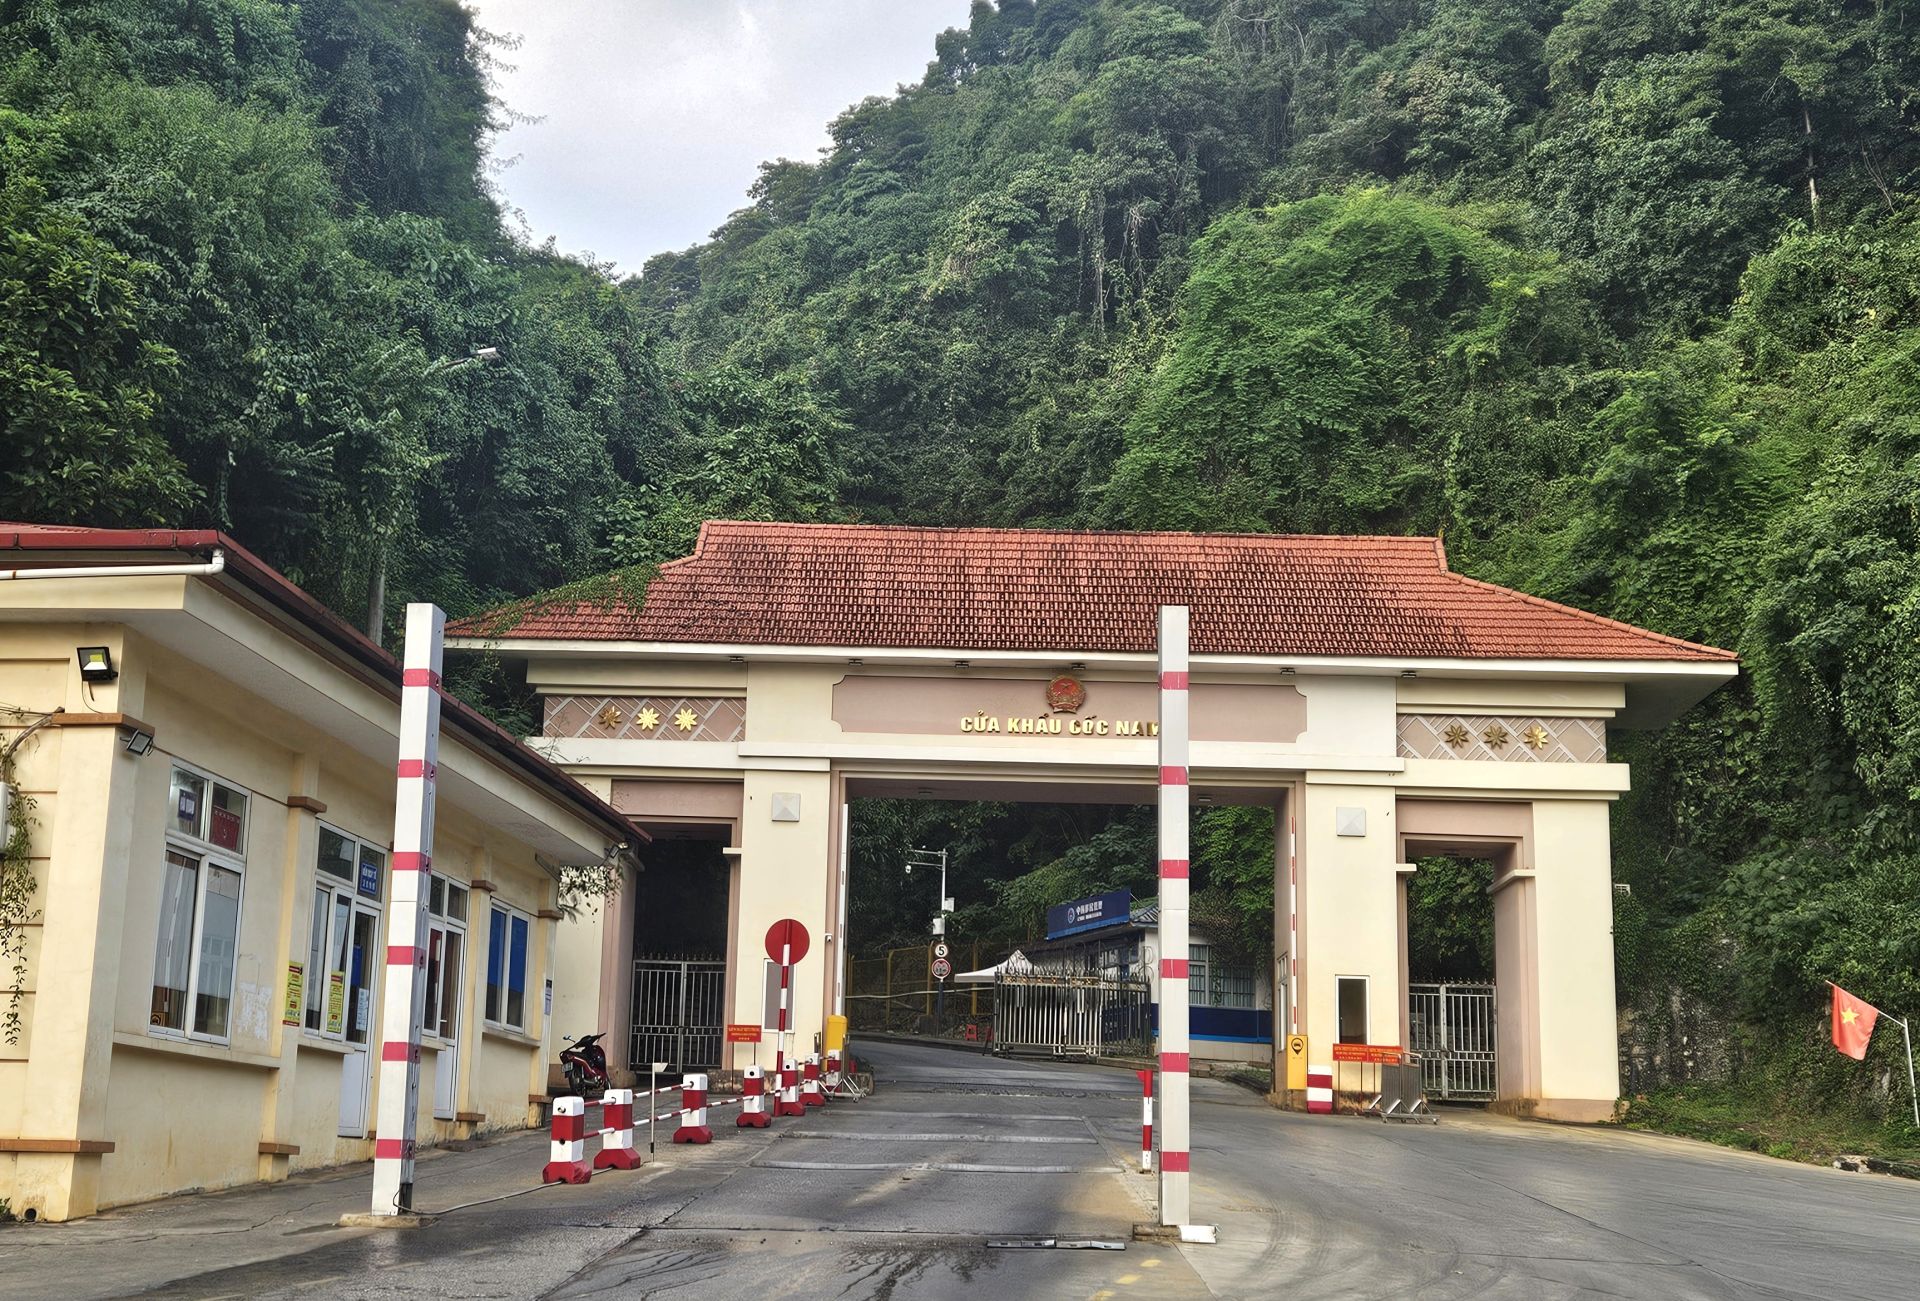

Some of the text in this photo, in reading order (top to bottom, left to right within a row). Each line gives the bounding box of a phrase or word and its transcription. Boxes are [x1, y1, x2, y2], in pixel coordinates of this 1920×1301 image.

[960, 709, 1000, 733] CỬA
[1007, 712, 1062, 735] KHẨU
[1069, 715, 1108, 736] CỐC
[938, 946, 945, 956] 5
